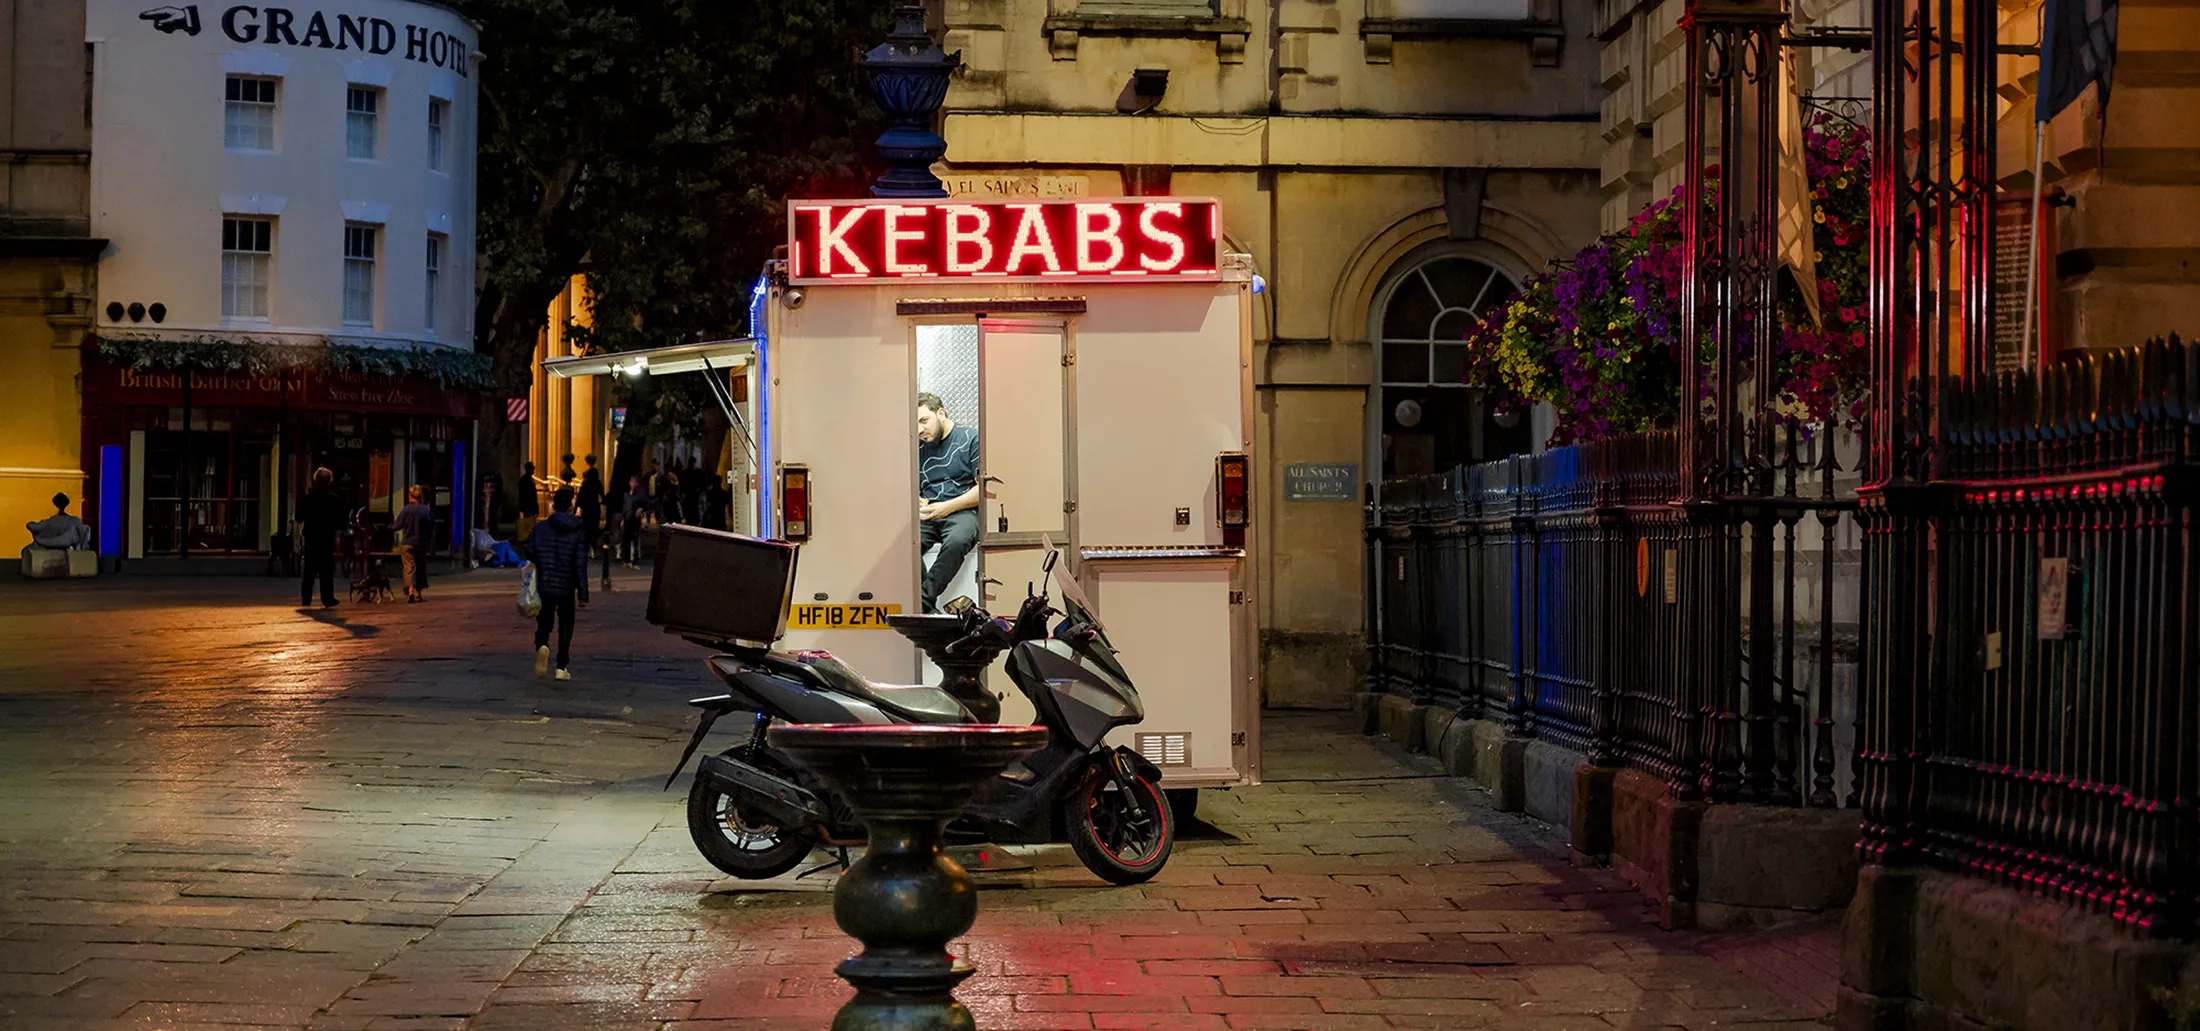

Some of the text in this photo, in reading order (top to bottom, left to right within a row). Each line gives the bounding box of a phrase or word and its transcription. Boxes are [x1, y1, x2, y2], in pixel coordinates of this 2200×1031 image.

[221, 4, 468, 79] GRAND HOTEL
[818, 204, 1185, 273] KEBABS
[120, 367, 183, 389] British
[361, 387, 384, 403] Free
[1289, 466, 1349, 478] ALL SAINTS
[798, 606, 888, 625] HF18 ZFN
